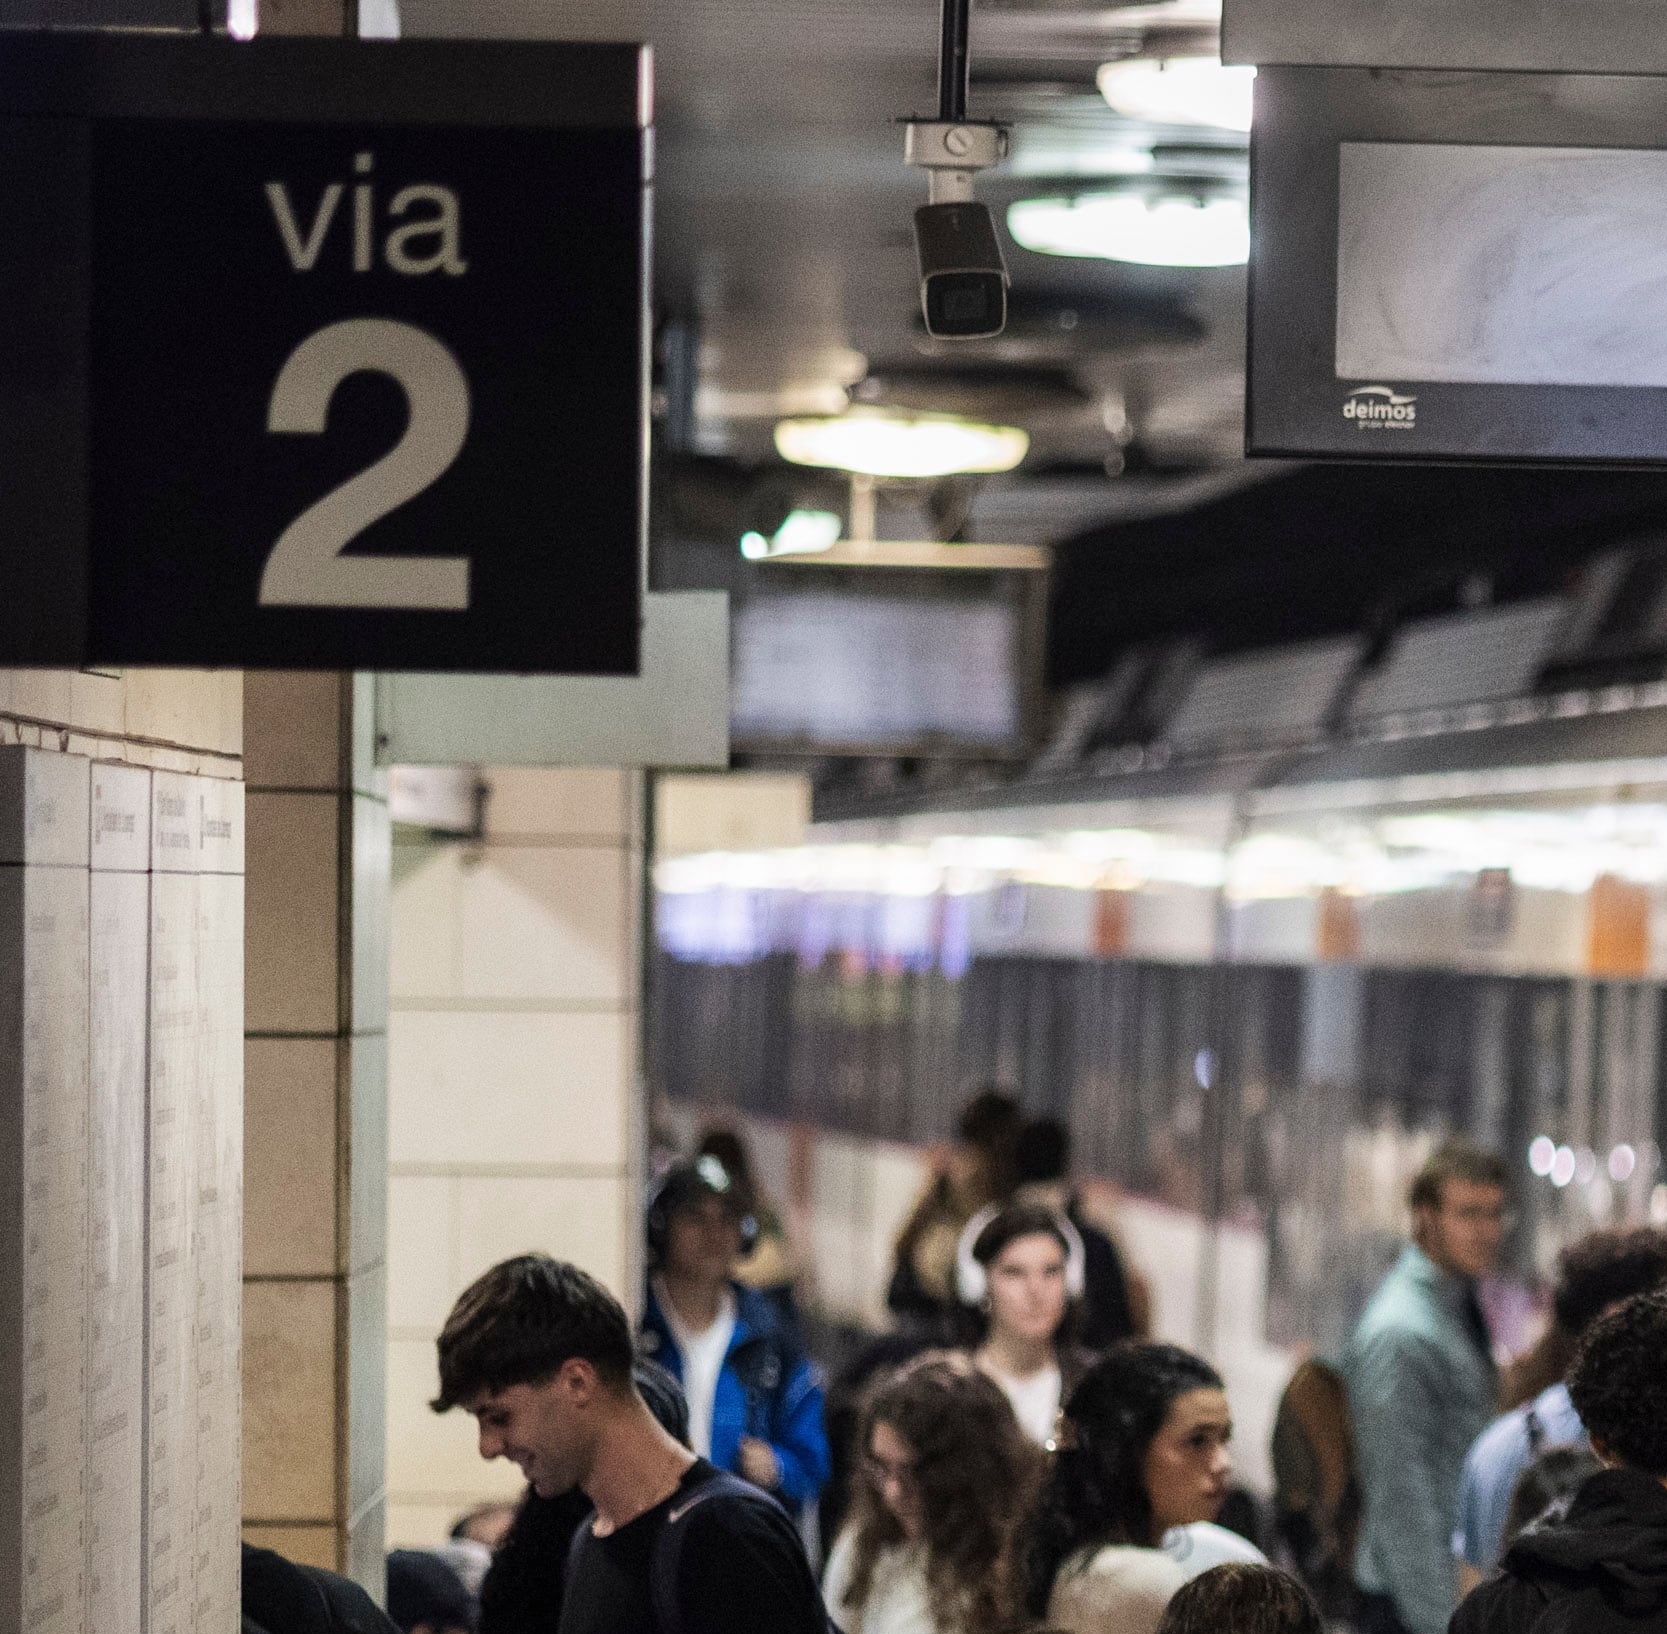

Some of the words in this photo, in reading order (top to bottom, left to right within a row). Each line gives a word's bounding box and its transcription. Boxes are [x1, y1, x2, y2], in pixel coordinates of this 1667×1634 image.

[265, 152, 468, 276] via
[257, 316, 471, 611] 2
[1342, 398, 1417, 420] deimos
